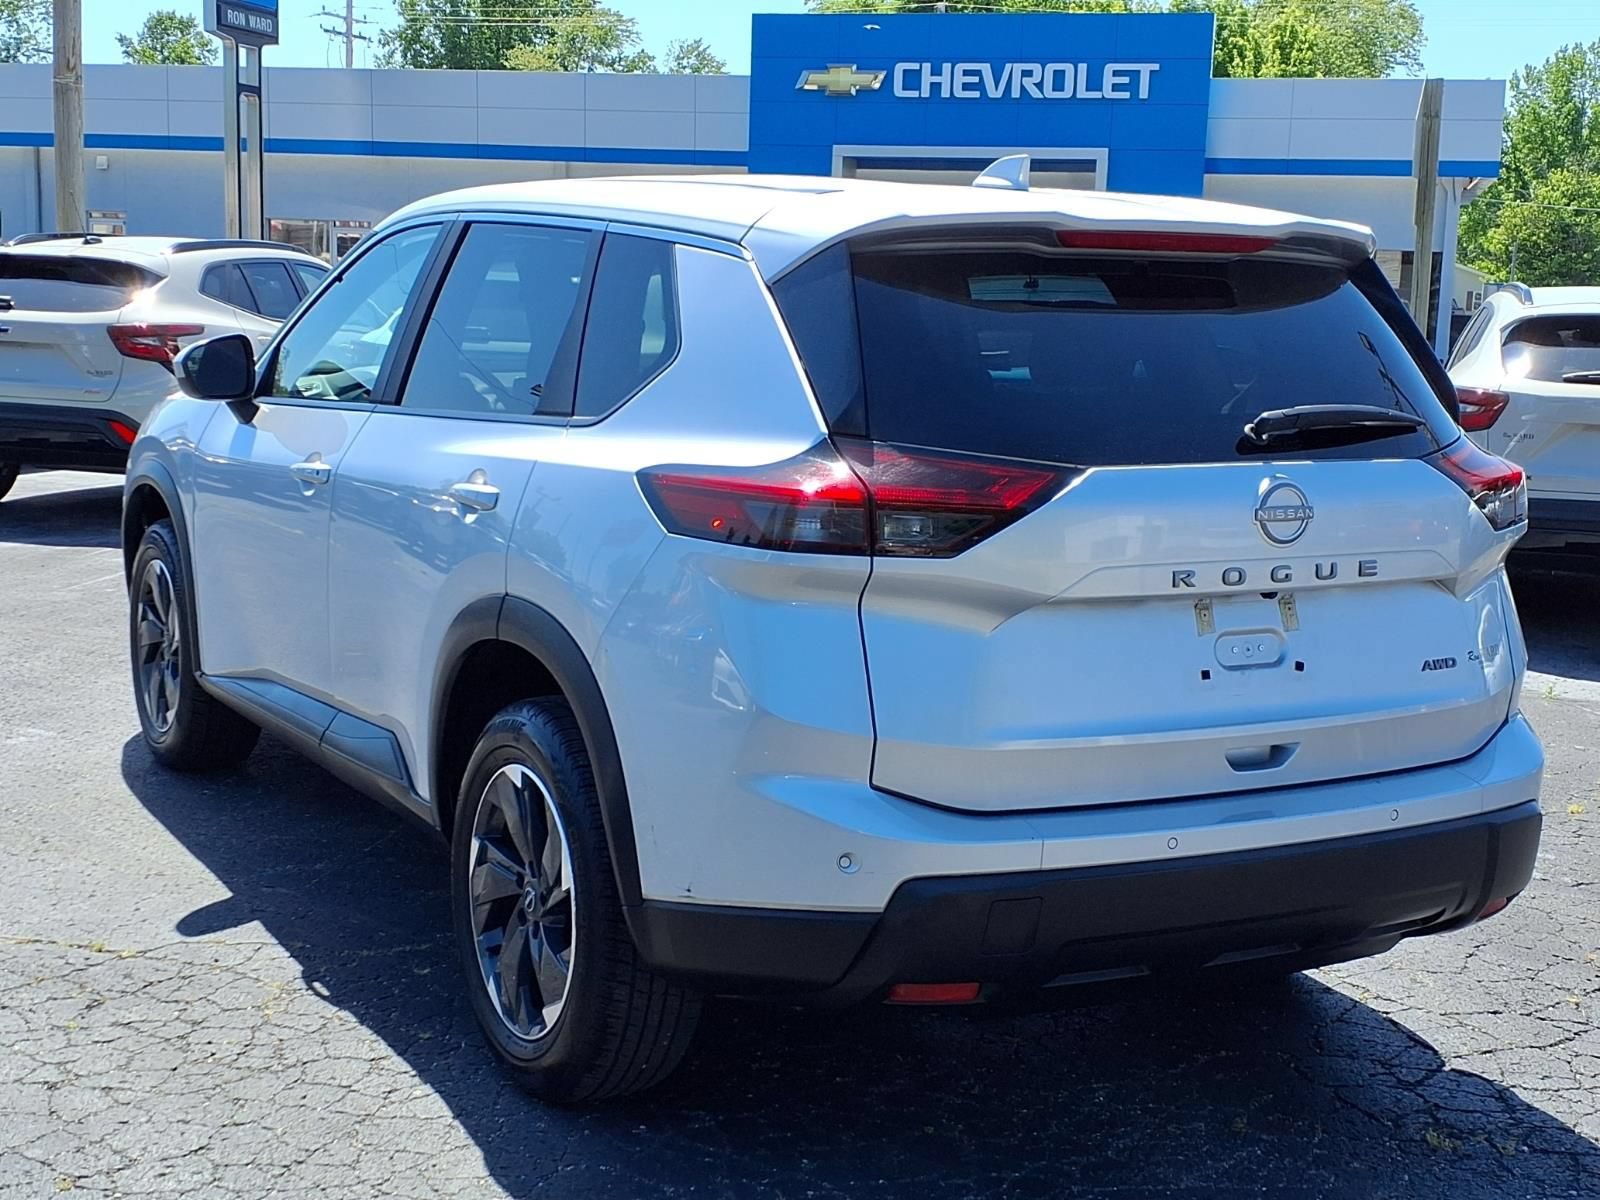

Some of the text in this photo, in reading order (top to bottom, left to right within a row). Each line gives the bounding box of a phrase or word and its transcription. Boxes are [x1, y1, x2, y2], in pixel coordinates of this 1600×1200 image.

[227, 9, 273, 33] RON WARD
[893, 62, 1160, 99] CHEVROLET
[1257, 508, 1313, 520] NISSAN
[1171, 559, 1379, 589] ROGUE
[1421, 657, 1457, 672] AWD
